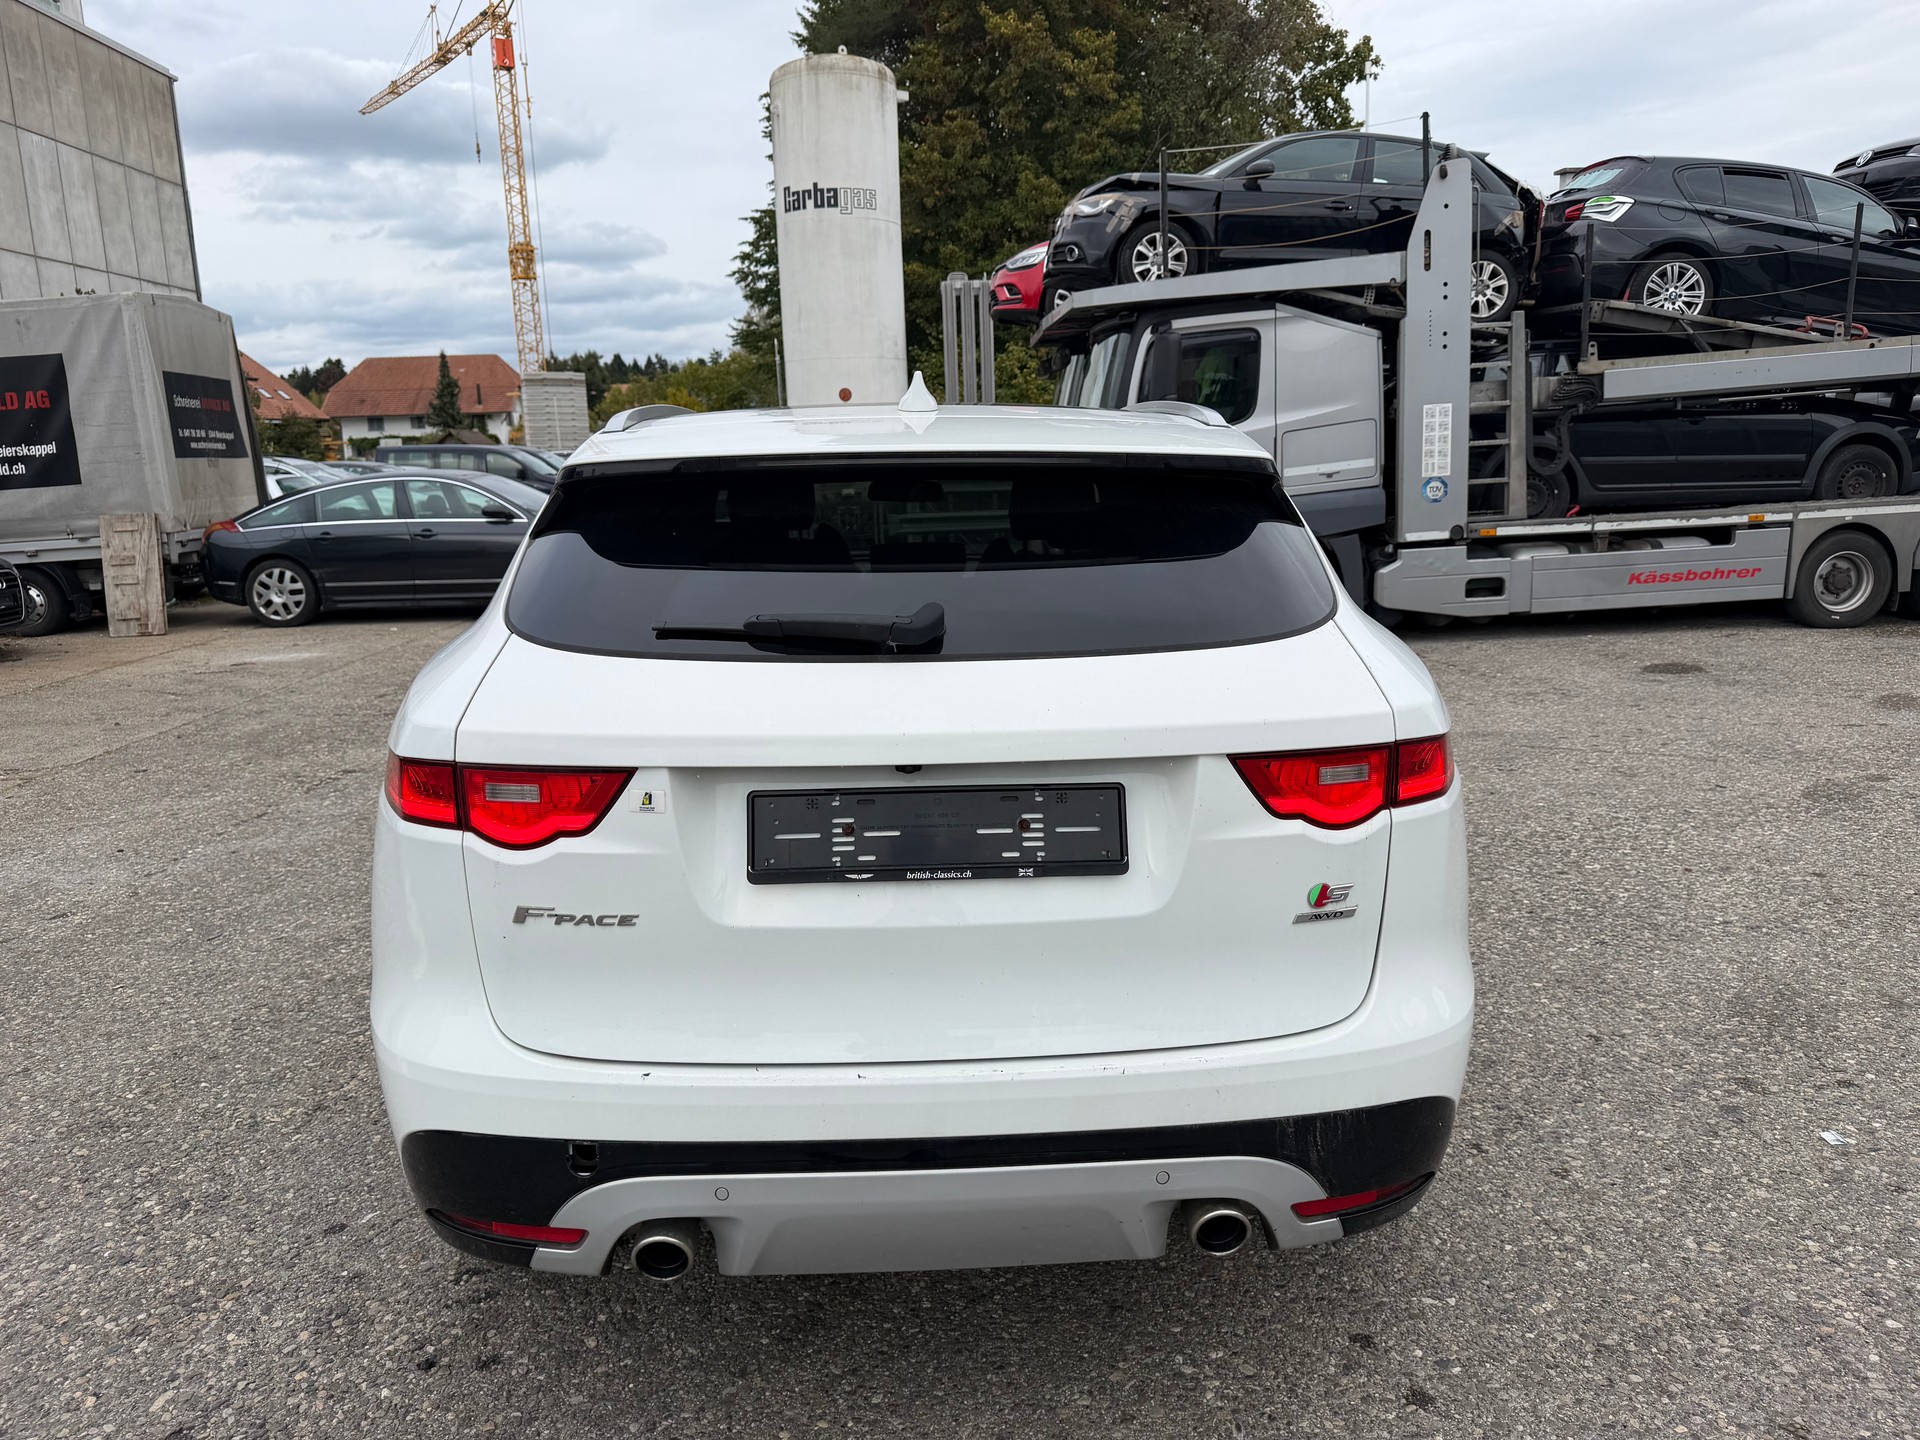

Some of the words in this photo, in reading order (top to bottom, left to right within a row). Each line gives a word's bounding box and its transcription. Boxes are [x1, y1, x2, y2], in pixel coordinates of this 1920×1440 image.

[783, 182, 877, 214] Carbagas
[24, 389, 51, 410] AG
[1628, 566, 1762, 586] Kässbohrer
[906, 869, 972, 879] british-classics.ch
[1308, 910, 1344, 921] AWD
